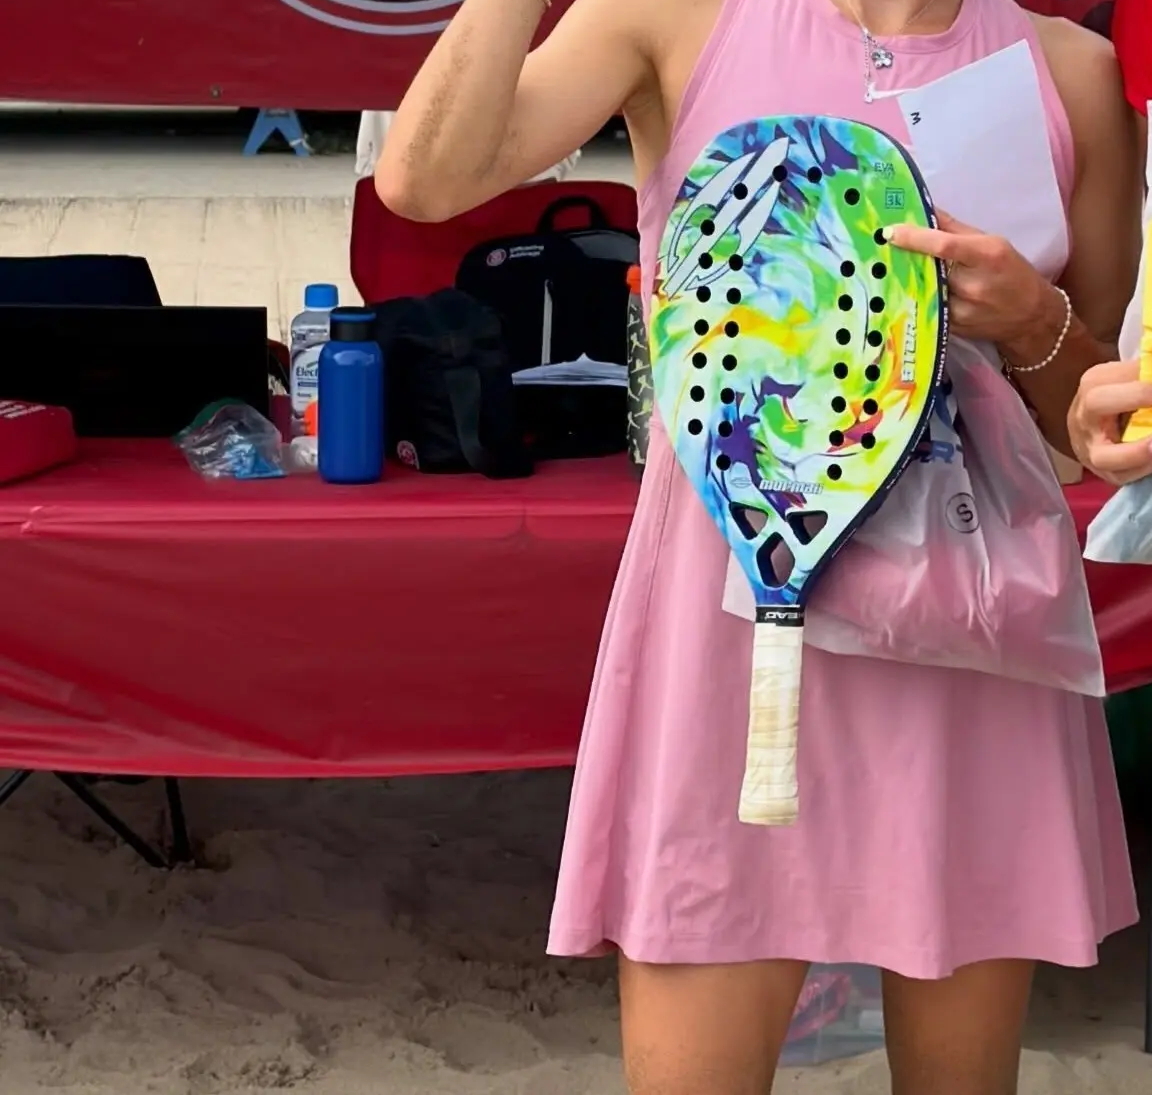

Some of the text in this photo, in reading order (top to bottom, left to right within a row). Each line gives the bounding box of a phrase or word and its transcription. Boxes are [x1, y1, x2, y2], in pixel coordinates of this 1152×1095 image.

[910, 111, 922, 126] 3
[874, 162, 895, 173] EVA
[956, 503, 974, 523] S
[765, 610, 803, 619] EAD
